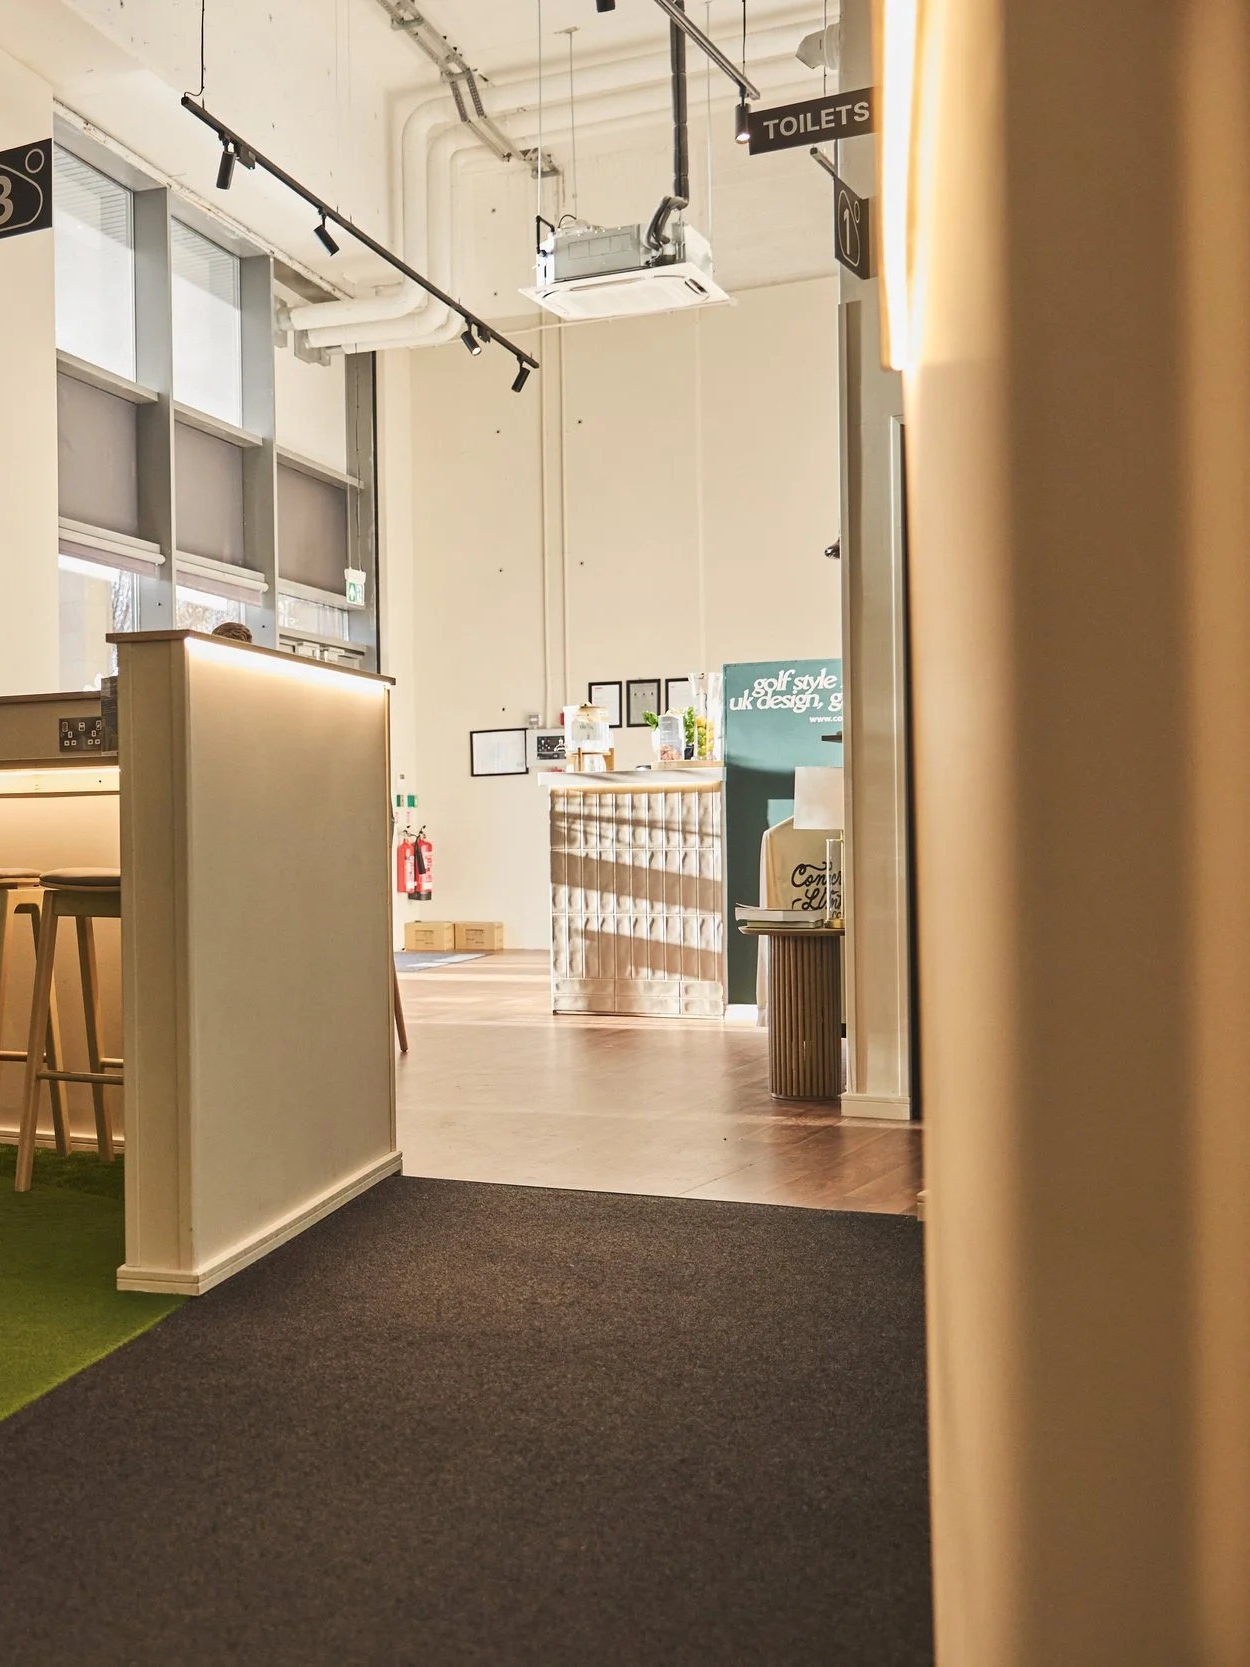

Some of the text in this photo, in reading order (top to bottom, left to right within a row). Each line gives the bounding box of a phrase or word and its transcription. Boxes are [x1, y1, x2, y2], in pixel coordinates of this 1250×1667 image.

[763, 101, 870, 140] TOILETS
[843, 208, 850, 255] 1
[751, 667, 838, 698] golf style
[729, 688, 754, 711] uk
[756, 689, 824, 713] design,
